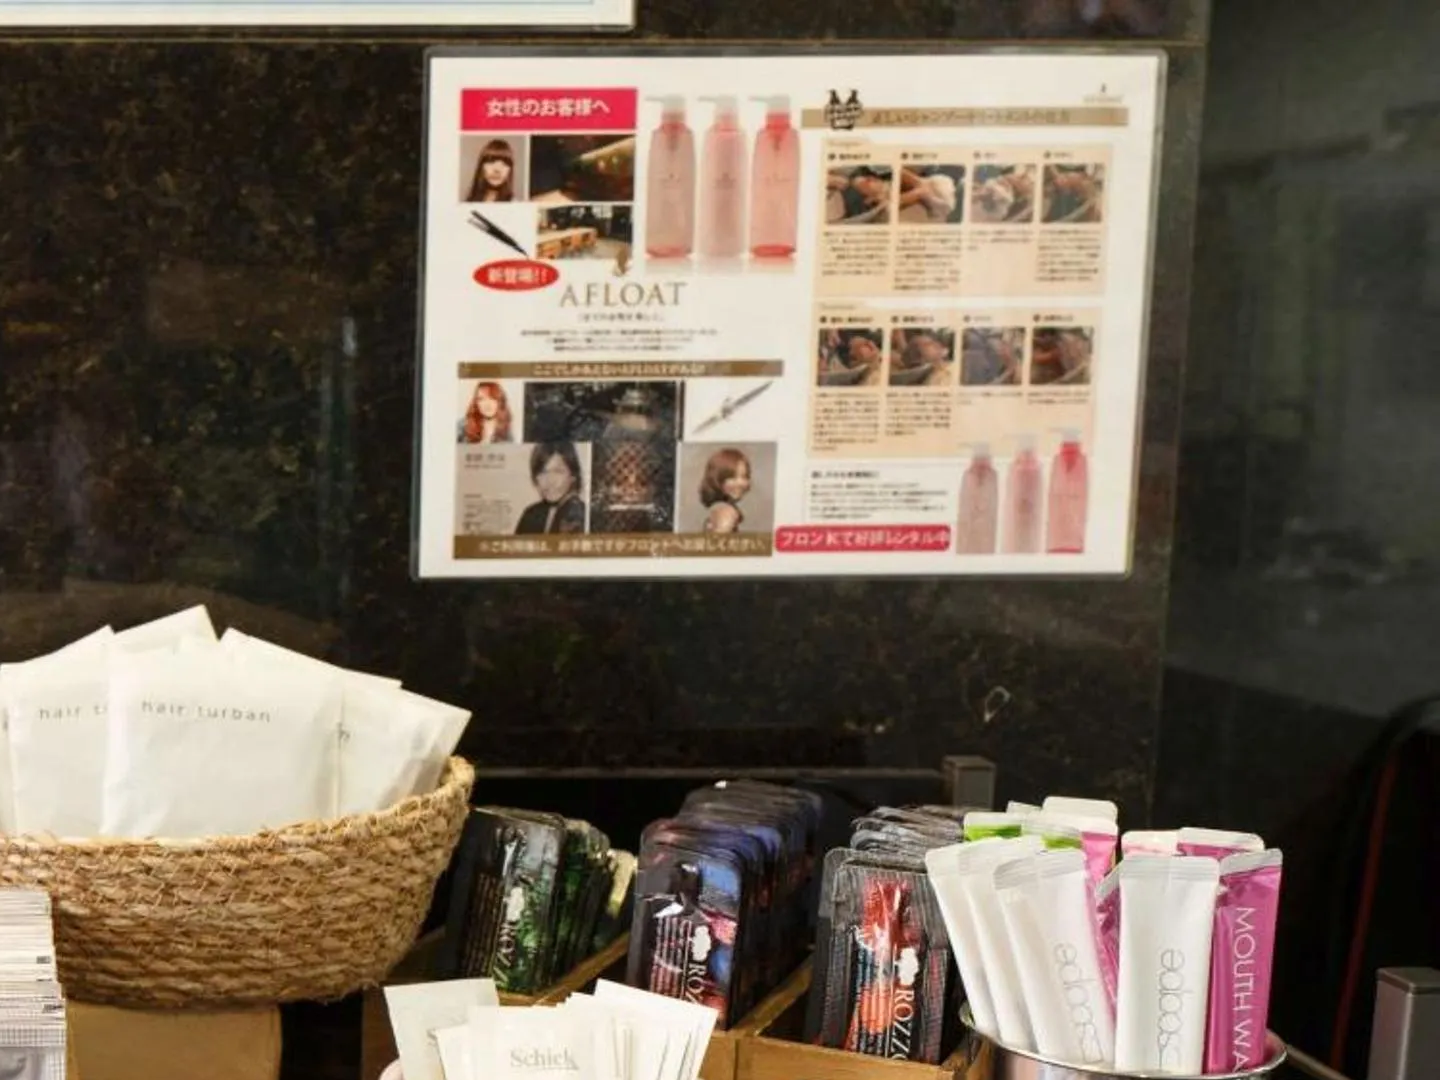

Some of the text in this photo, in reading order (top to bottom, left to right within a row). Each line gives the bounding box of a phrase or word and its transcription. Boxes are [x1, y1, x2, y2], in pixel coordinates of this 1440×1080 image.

[486, 97, 611, 119] 女性のお客様へ
[560, 281, 688, 308] AFLOAT
[141, 700, 272, 724] hair turban
[1231, 907, 1258, 1014] MOUTH
[510, 1045, 580, 1071] Schick
